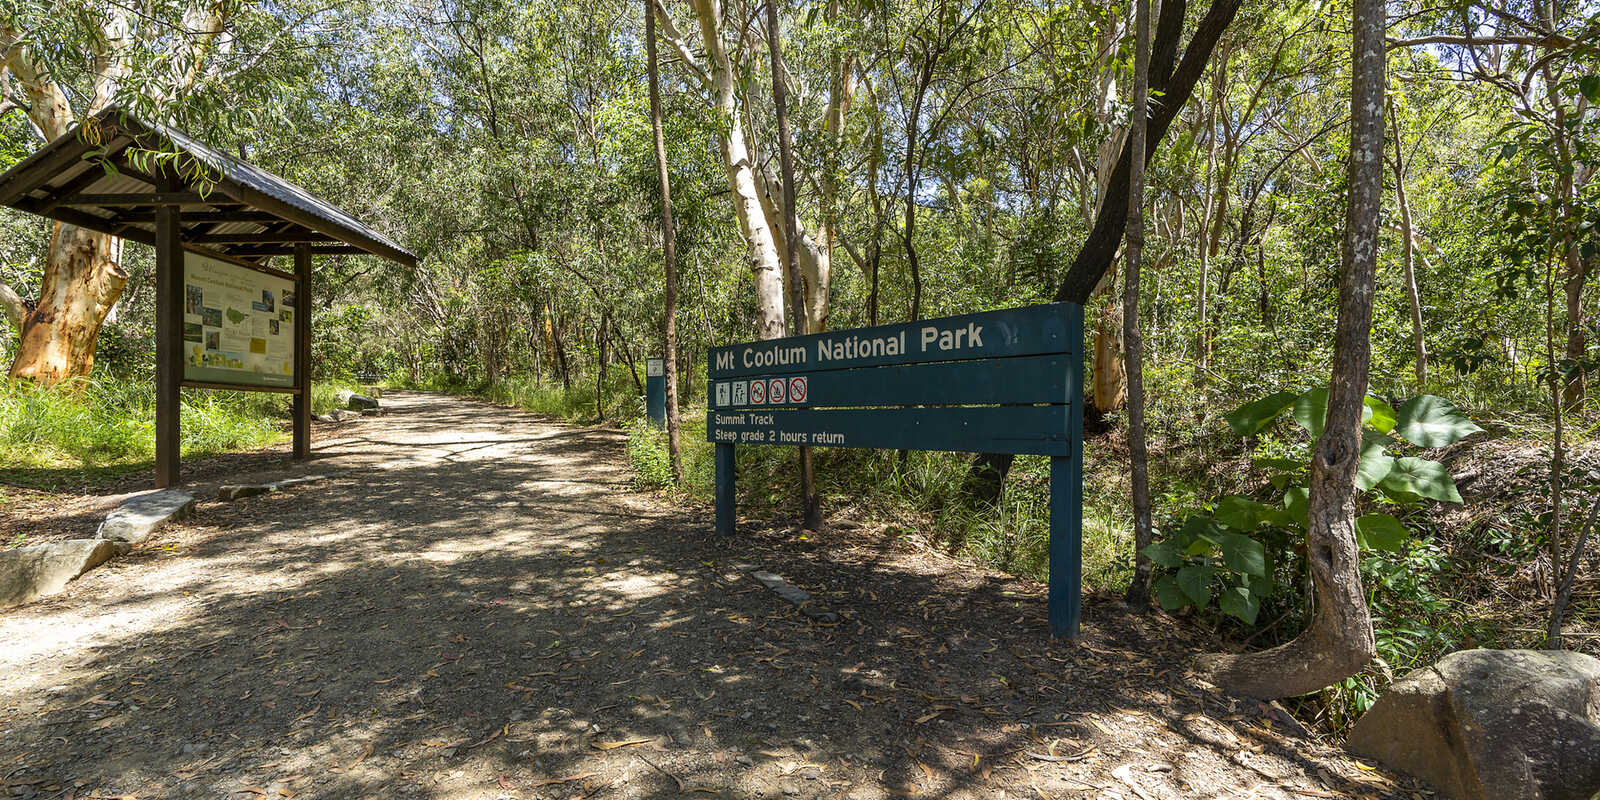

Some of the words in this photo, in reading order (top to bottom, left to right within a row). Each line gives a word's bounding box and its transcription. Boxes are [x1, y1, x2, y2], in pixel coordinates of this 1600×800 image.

[716, 351, 735, 371] Mt
[743, 345, 807, 369] Coolum
[817, 334, 906, 362] National
[921, 322, 984, 353] Park
[715, 414, 746, 425] Summit
[749, 414, 774, 425] Track
[715, 429, 738, 442] Steep
[740, 429, 765, 443] grade
[768, 430, 776, 442] 2
[780, 430, 808, 443] hours
[812, 431, 845, 444] return
